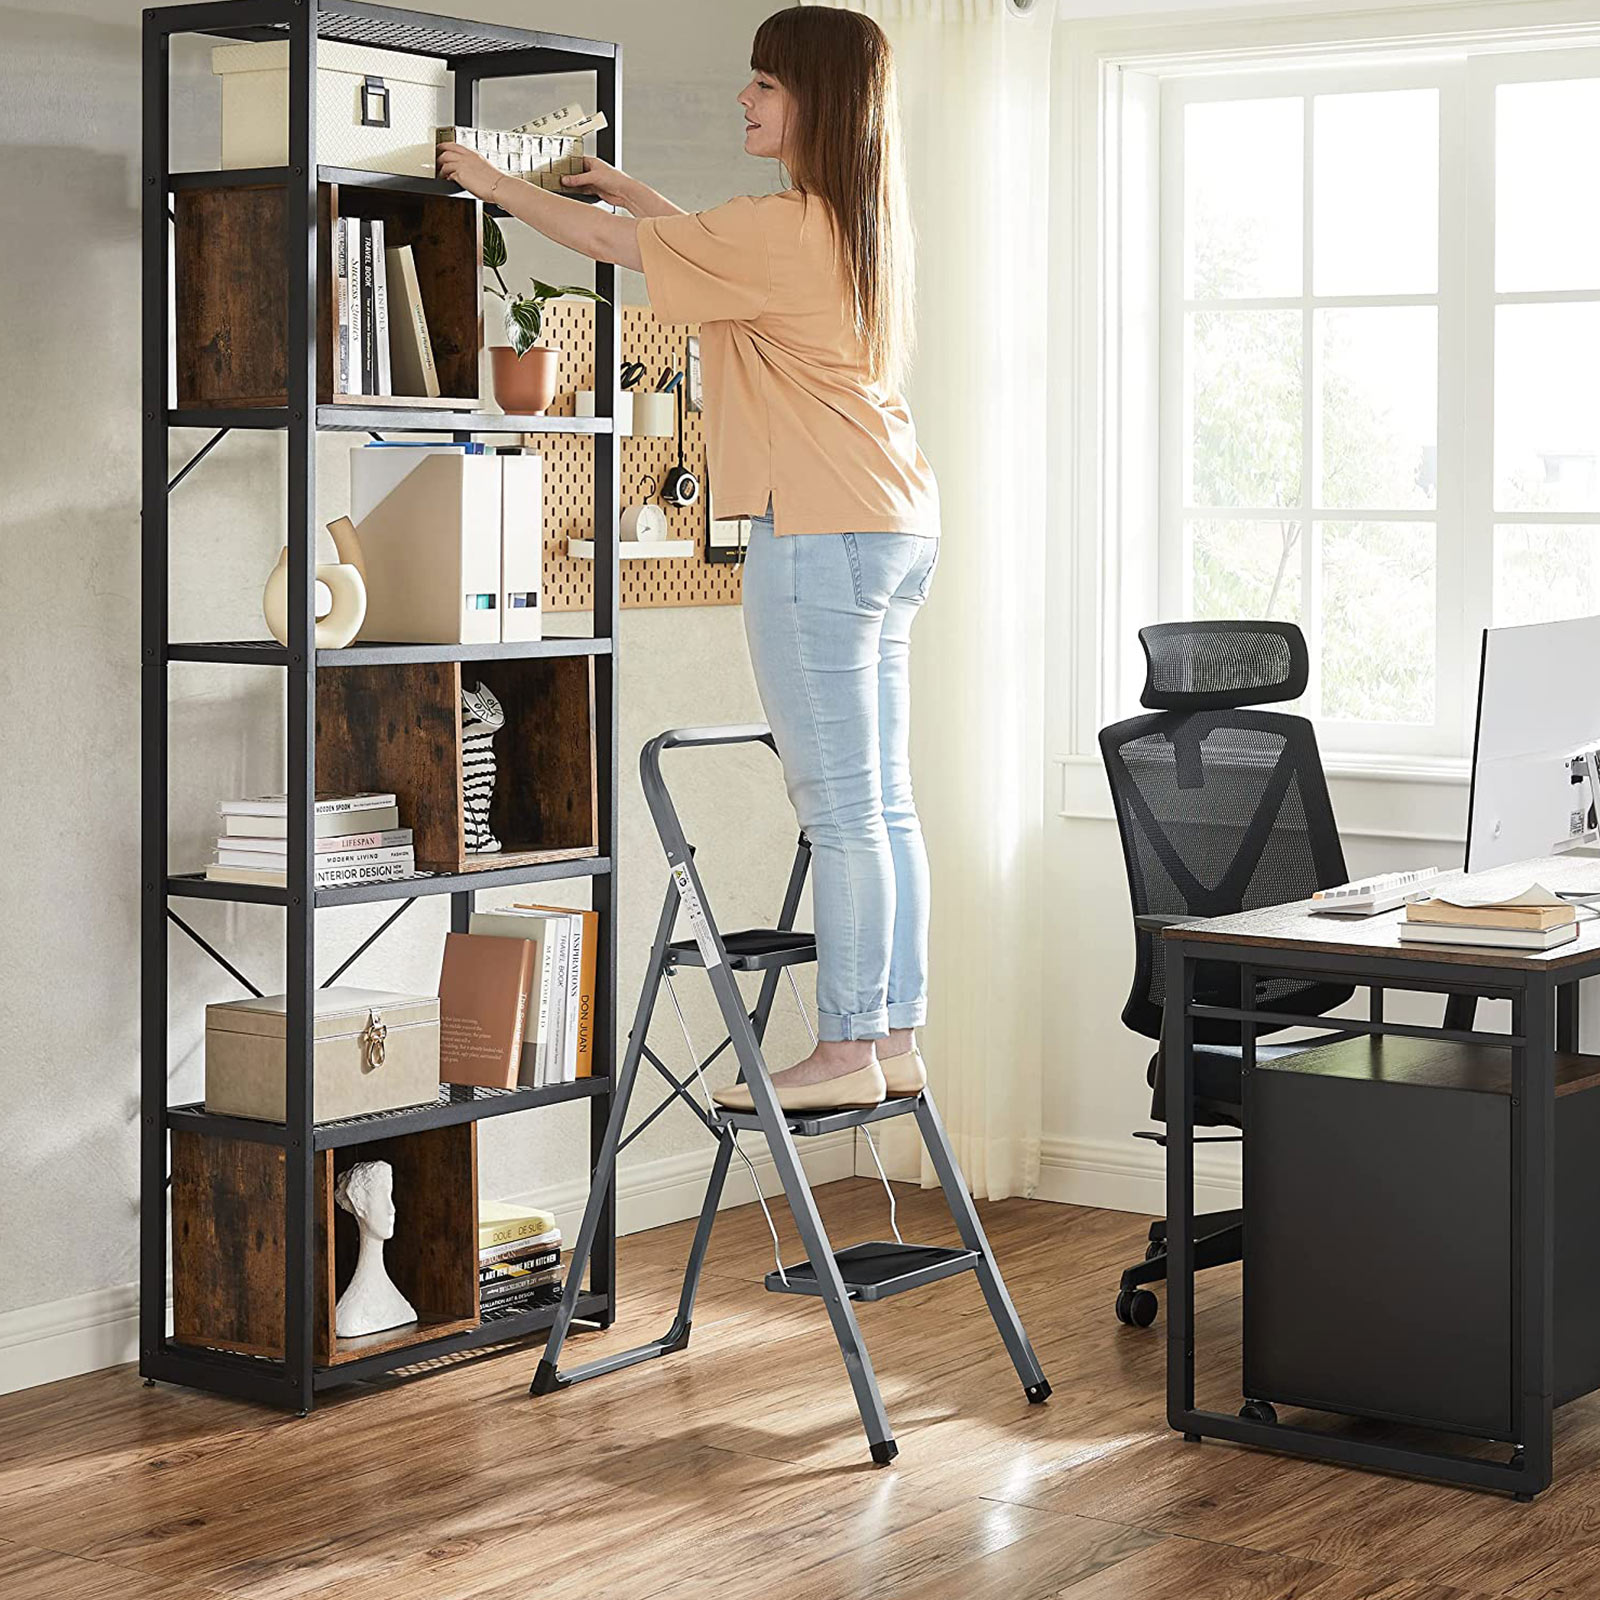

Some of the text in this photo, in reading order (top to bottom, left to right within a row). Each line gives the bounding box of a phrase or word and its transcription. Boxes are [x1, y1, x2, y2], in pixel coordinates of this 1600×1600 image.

[364, 237, 372, 264] TRAVEL
[351, 258, 360, 342] Success Quotes
[378, 285, 386, 333] KINFOLK
[341, 837, 376, 848] LIFESPAN
[357, 853, 378, 861] LIVING
[315, 866, 392, 882] INTERIOR DESIGN
[557, 935, 567, 988] TRAVEL BOOK
[571, 933, 581, 997] INSPIRATIONS
[579, 995, 589, 1053] DON JUAN
[535, 1253, 557, 1267] KITCHEN
